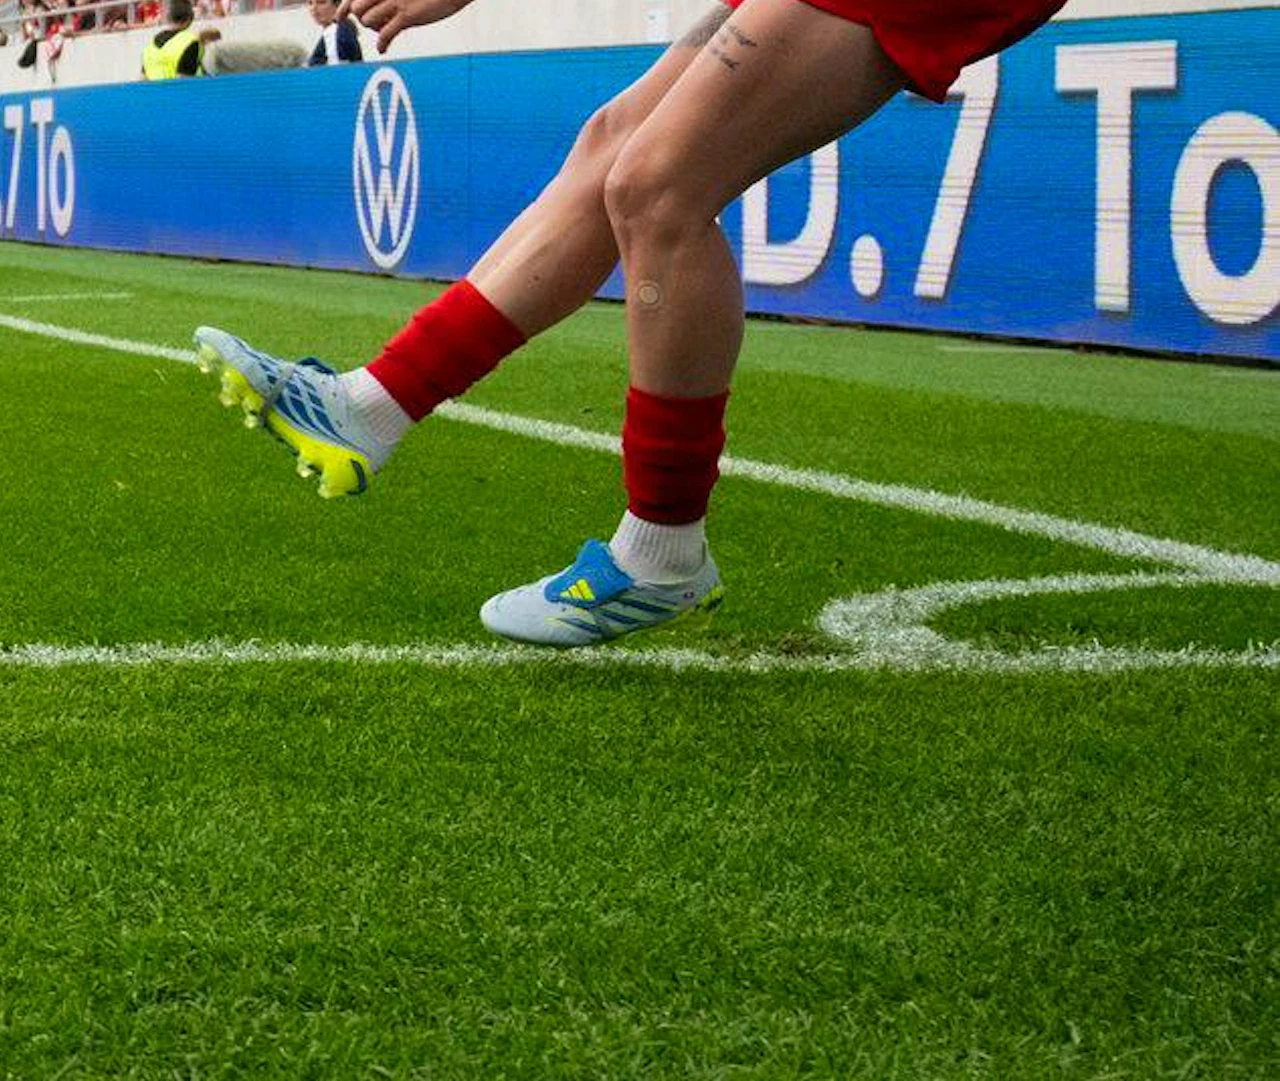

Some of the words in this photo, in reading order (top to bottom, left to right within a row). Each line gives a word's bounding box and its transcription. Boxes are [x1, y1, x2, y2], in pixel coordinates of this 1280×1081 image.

[30, 96, 76, 237] To
[742, 54, 1000, 300] D.7
[1054, 39, 1280, 324] To
